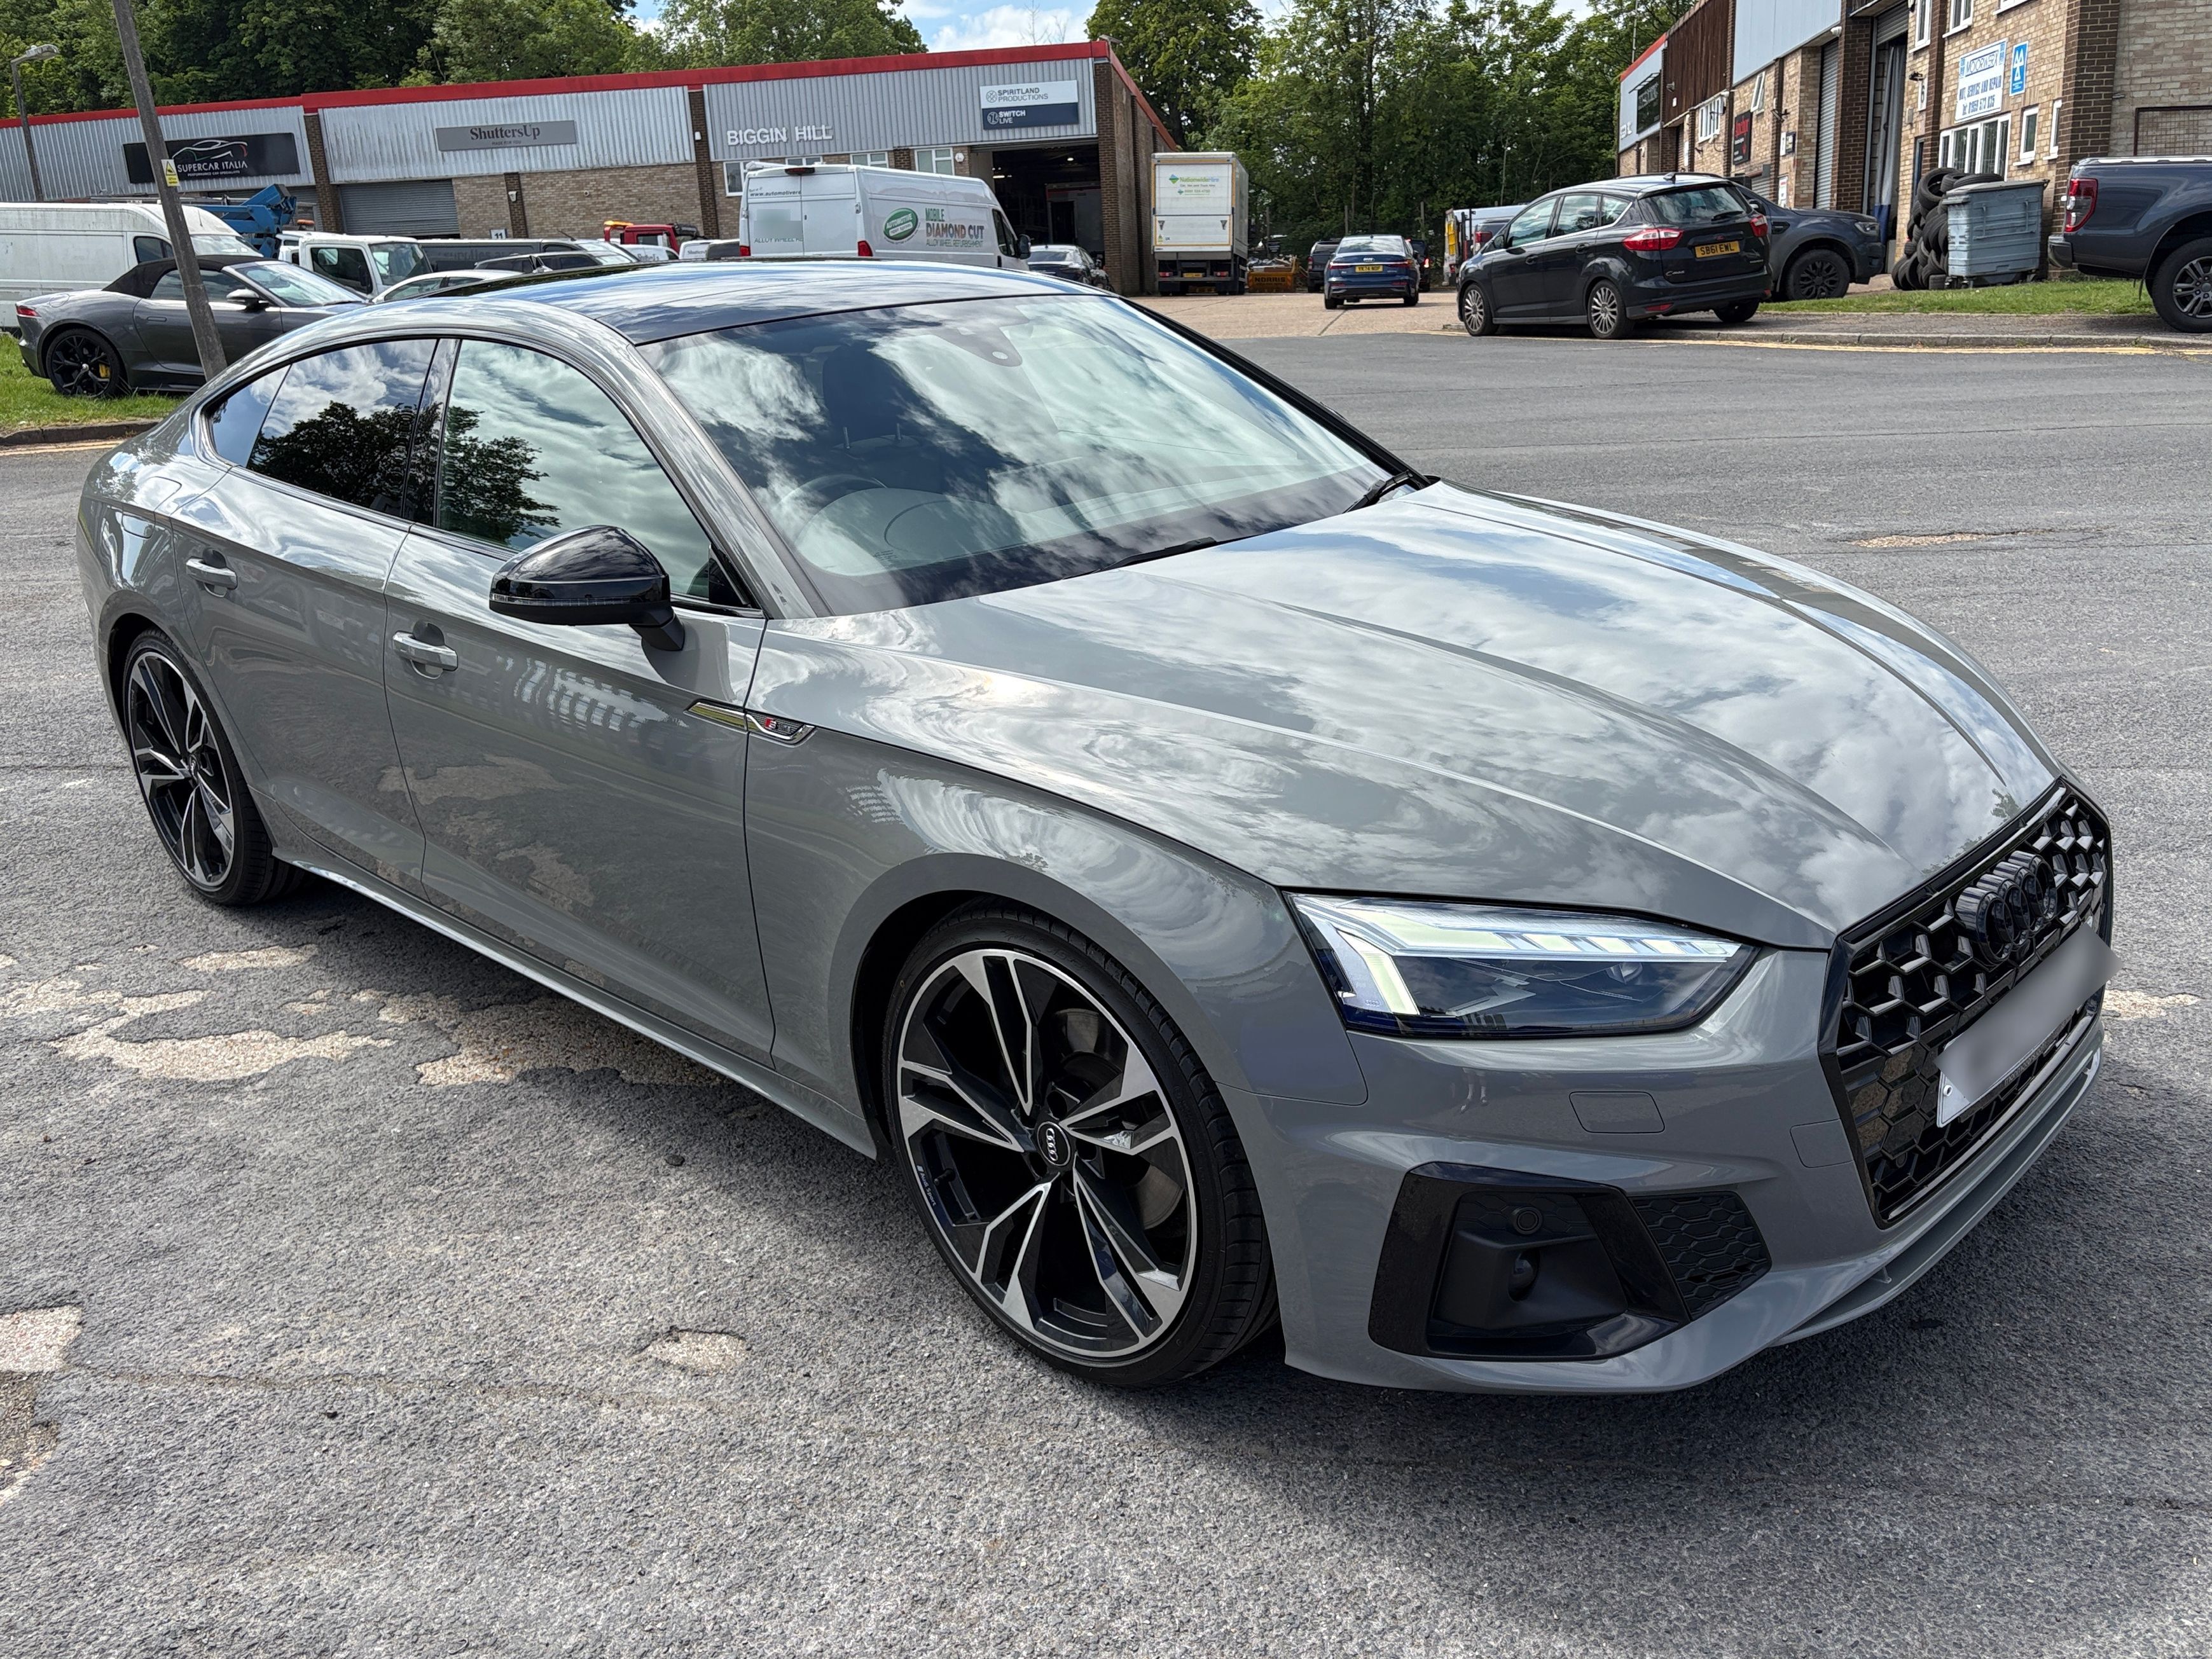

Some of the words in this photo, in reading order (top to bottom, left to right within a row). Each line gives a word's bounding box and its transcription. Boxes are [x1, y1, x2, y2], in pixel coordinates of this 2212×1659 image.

[998, 87, 1040, 96] SPIRITLAND
[999, 93, 1048, 102] PRODUCTIONS
[999, 109, 1026, 118] SWITCH
[469, 125, 541, 141] ShuttersUp
[727, 127, 788, 146] BIGGIN
[795, 124, 833, 142] HILL
[177, 162, 219, 173] SUPERCAR
[222, 160, 248, 170] ITALIA
[925, 207, 945, 222] MOBILE
[925, 223, 966, 239] DIAMOND
[968, 225, 985, 240] CUT
[1700, 245, 1718, 256] SB61
[1719, 242, 1735, 252] EWL
[920, 1173, 930, 1188] Audi
[926, 1188, 937, 1206] Sport
